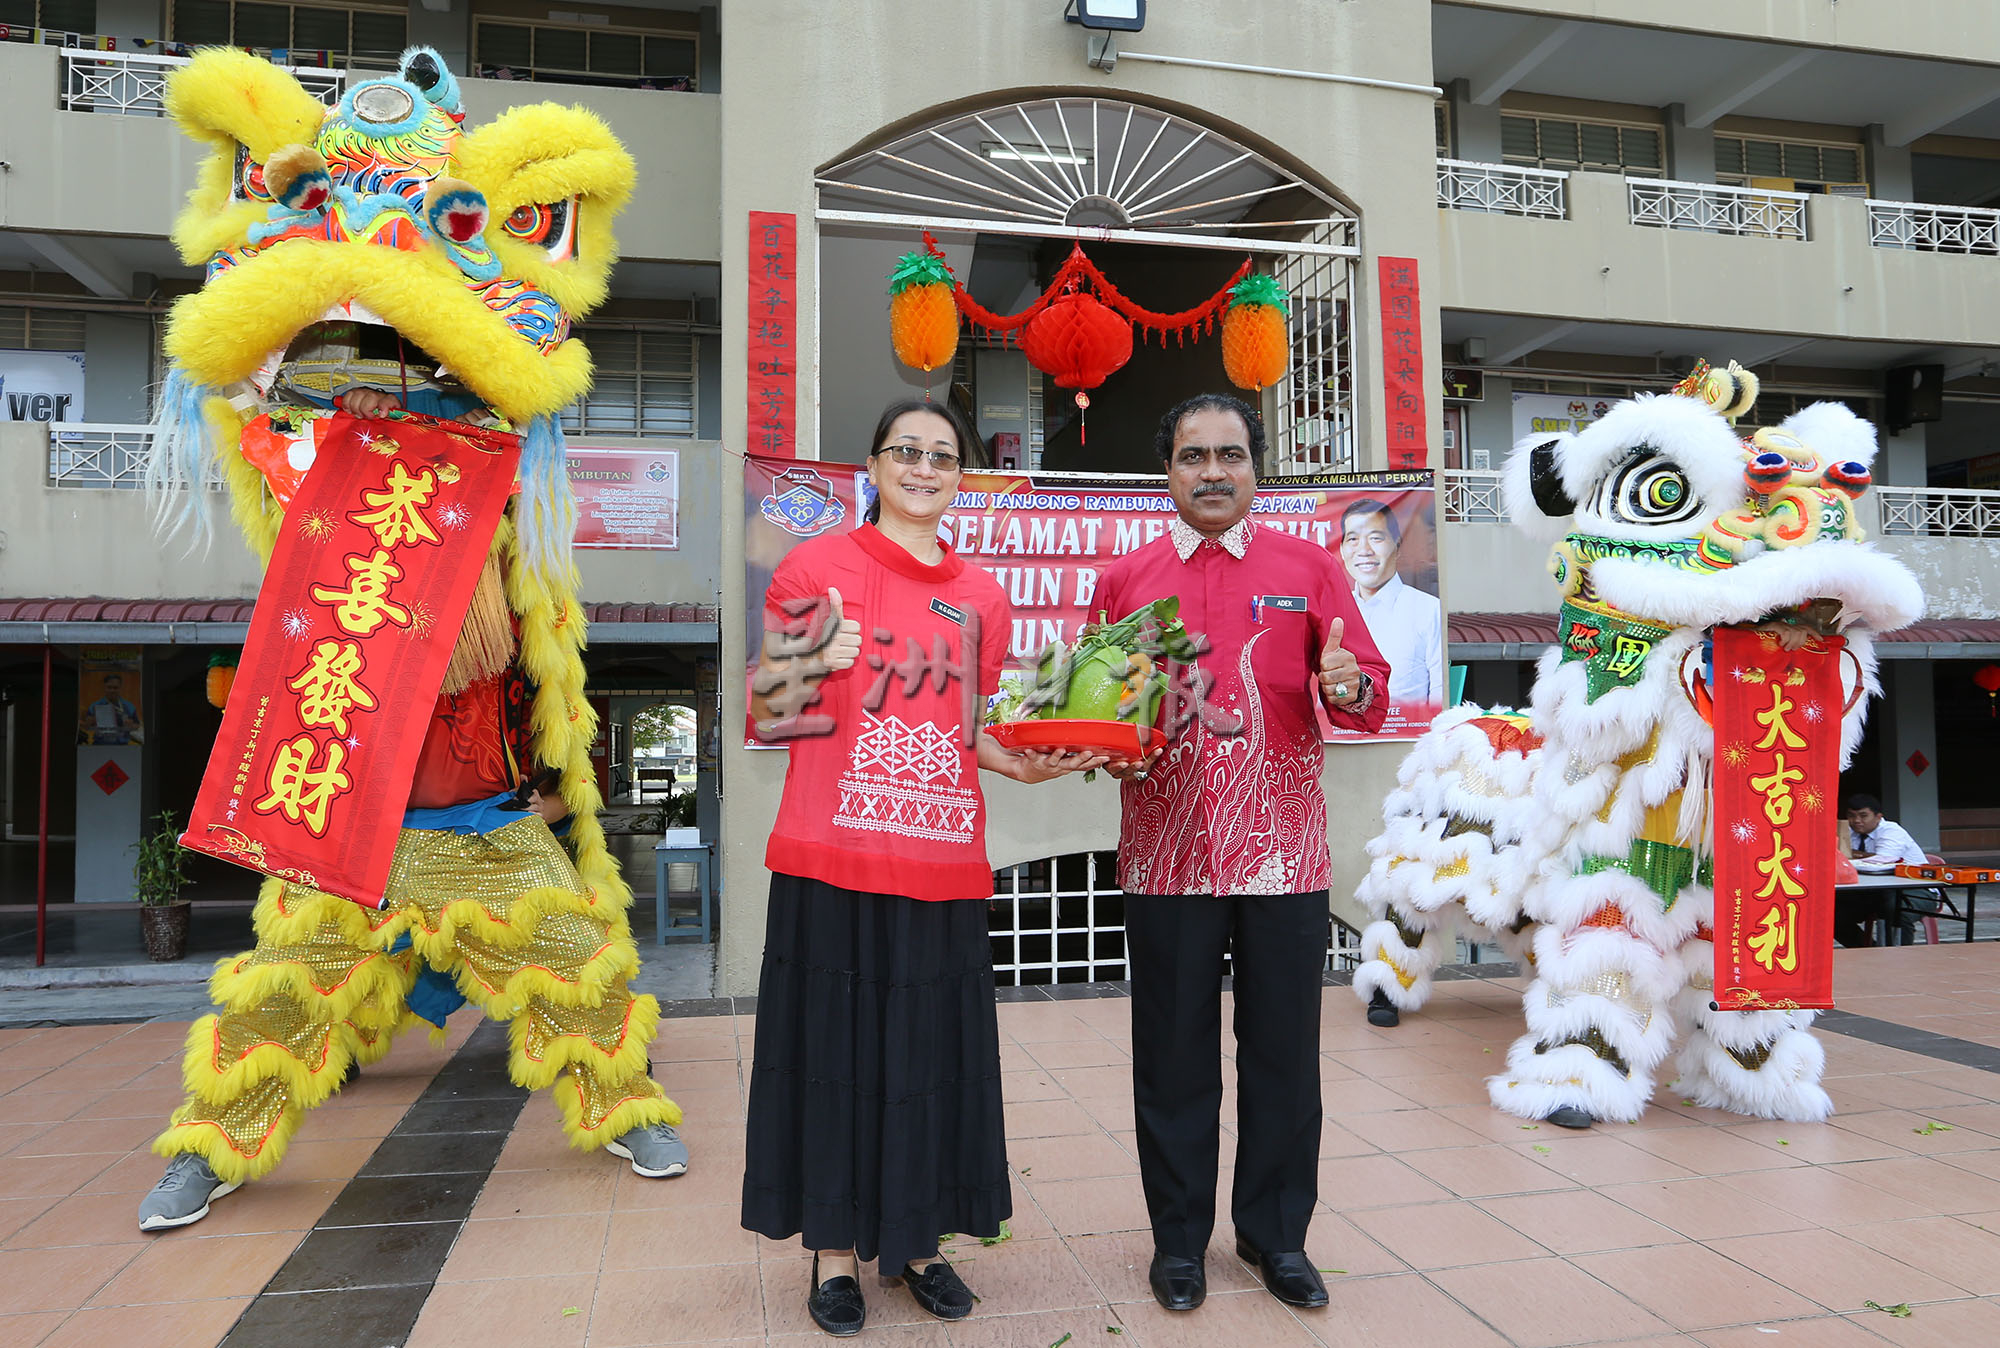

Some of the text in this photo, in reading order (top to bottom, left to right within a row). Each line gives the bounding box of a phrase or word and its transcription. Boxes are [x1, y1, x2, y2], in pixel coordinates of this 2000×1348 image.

[992, 493, 1080, 510] TANJONG
[1256, 476, 1309, 485] ANJONG
[936, 514, 1102, 556] SELAMAT
[253, 462, 439, 835] 恭喜發財
[1748, 683, 1807, 972] 大吉大利
